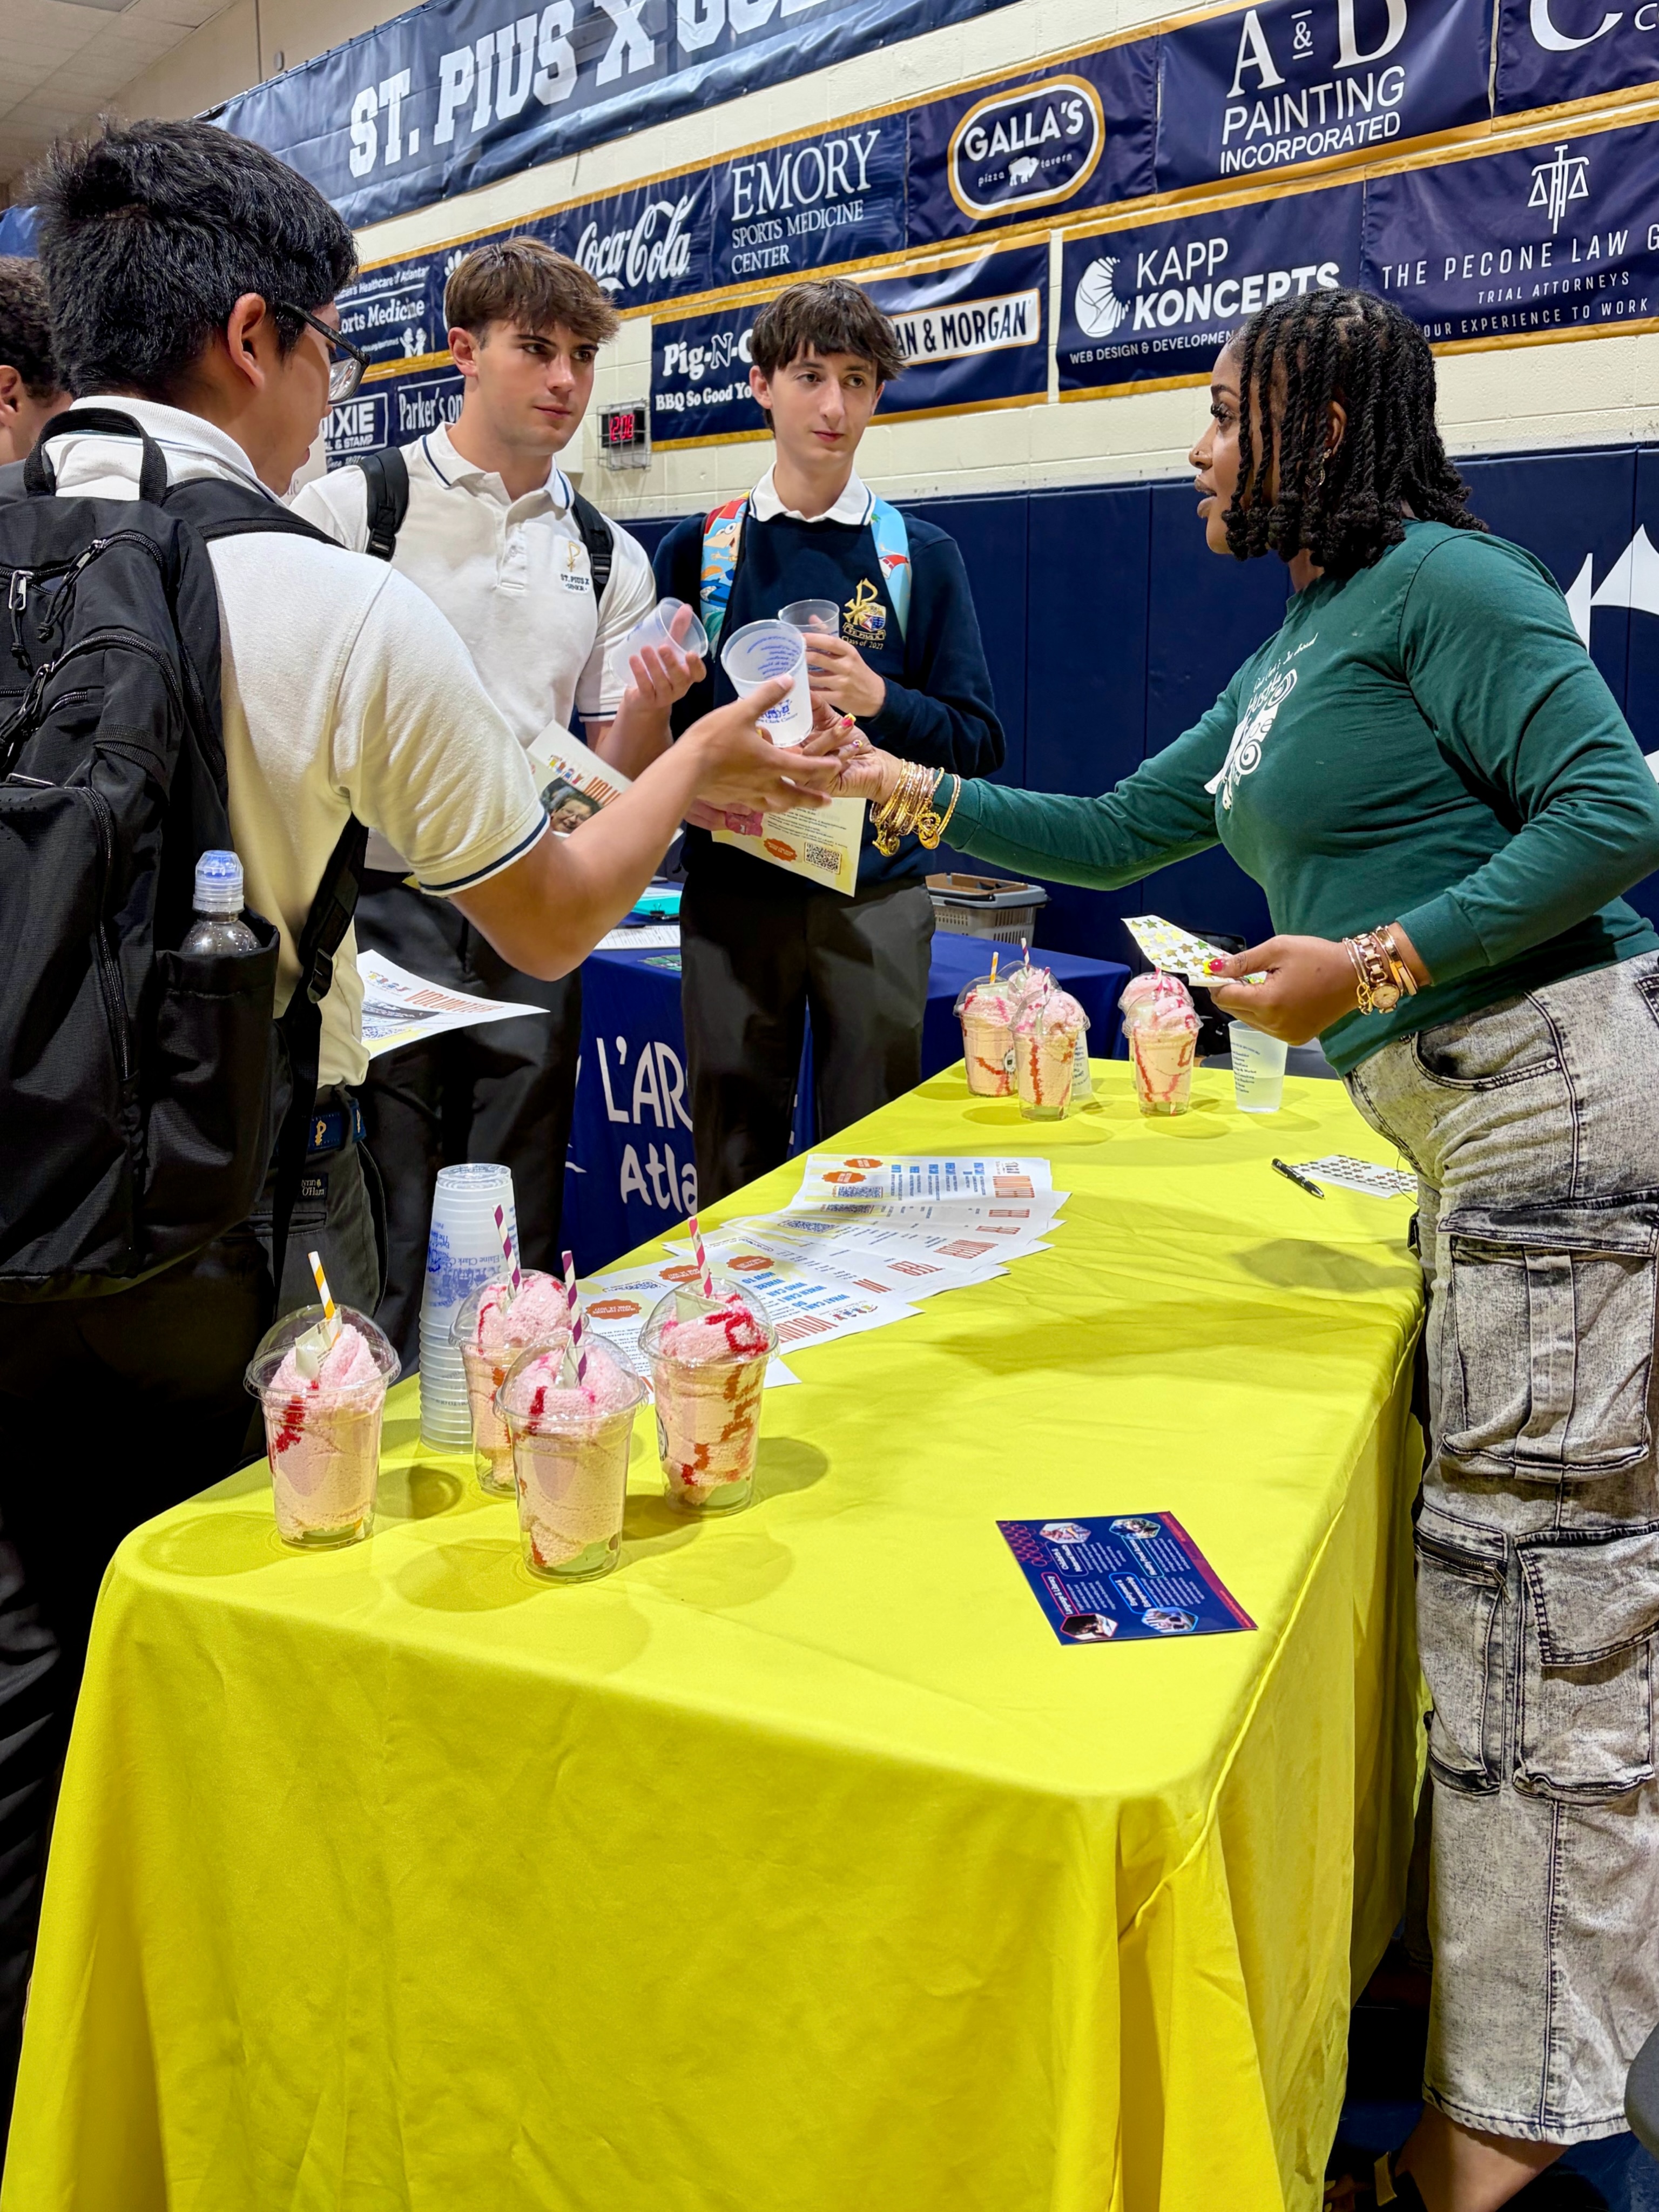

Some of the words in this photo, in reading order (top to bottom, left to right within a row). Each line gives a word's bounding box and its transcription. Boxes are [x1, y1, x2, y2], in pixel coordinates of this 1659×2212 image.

[1226, 10, 1285, 98] A
[1293, 22, 1313, 49] &
[349, 68, 419, 178] ST.
[433, 0, 577, 145] PIUS
[594, 0, 655, 86] X
[1222, 65, 1405, 145] PAINTING
[964, 99, 1084, 161] GALLA'S
[1220, 111, 1400, 174] INCORPORATED
[731, 129, 881, 221] EMORY
[978, 171, 1004, 187] pizza
[1041, 153, 1073, 168] tavern
[731, 215, 783, 249] SPORTS
[786, 199, 864, 237] MEDICINE
[576, 193, 695, 291] Coca-Cola
[1382, 261, 1427, 289] THE
[1444, 242, 1553, 281] PECONE
[1572, 229, 1629, 264] LAW
[731, 245, 791, 274] CENTER
[1136, 237, 1229, 288] KAPP
[1132, 262, 1340, 331] KONCEPTS
[1478, 286, 1522, 305] TRIAL
[1532, 271, 1630, 298] ATTORNEYS
[339, 313, 366, 334] orts
[367, 297, 425, 328] Medicine
[923, 319, 937, 353] &
[941, 300, 1026, 350] MORGAN
[1461, 308, 1561, 334] EXPERIENCE
[1572, 305, 1590, 319] TO
[1601, 298, 1648, 317] WORK
[1069, 351, 1093, 365] WEB
[1096, 344, 1138, 361] DESIGN
[1142, 342, 1149, 354] &
[1153, 329, 1234, 352] DEVELOPMEN
[399, 388, 446, 431] Parker's
[655, 392, 685, 412] BBQ
[686, 390, 702, 407] So
[703, 384, 733, 404] Good
[734, 381, 752, 399] Yo
[335, 439, 342, 450] &
[343, 434, 374, 449] STAMP
[571, 576, 584, 584] PIUS
[596, 1035, 693, 1133] L'AR
[301, 1179, 316, 1188] ynn
[620, 1142, 698, 1215] Atla
[458, 1257, 477, 1266] Clark
[479, 1254, 500, 1263] Elaine
[753, 1278, 786, 1291] WHERE
[756, 1271, 776, 1282] HOW
[766, 1286, 787, 1297] CAN
[787, 1282, 808, 1291] WHO
[801, 1285, 827, 1296] WHEN
[783, 1292, 800, 1303] CAN
[806, 1300, 822, 1309] CAN
[823, 1294, 851, 1305] WHAT
[1044, 1575, 1063, 1591] Literacy
[1117, 1583, 1140, 1606] Employment
[1056, 1595, 1075, 1614] Language
